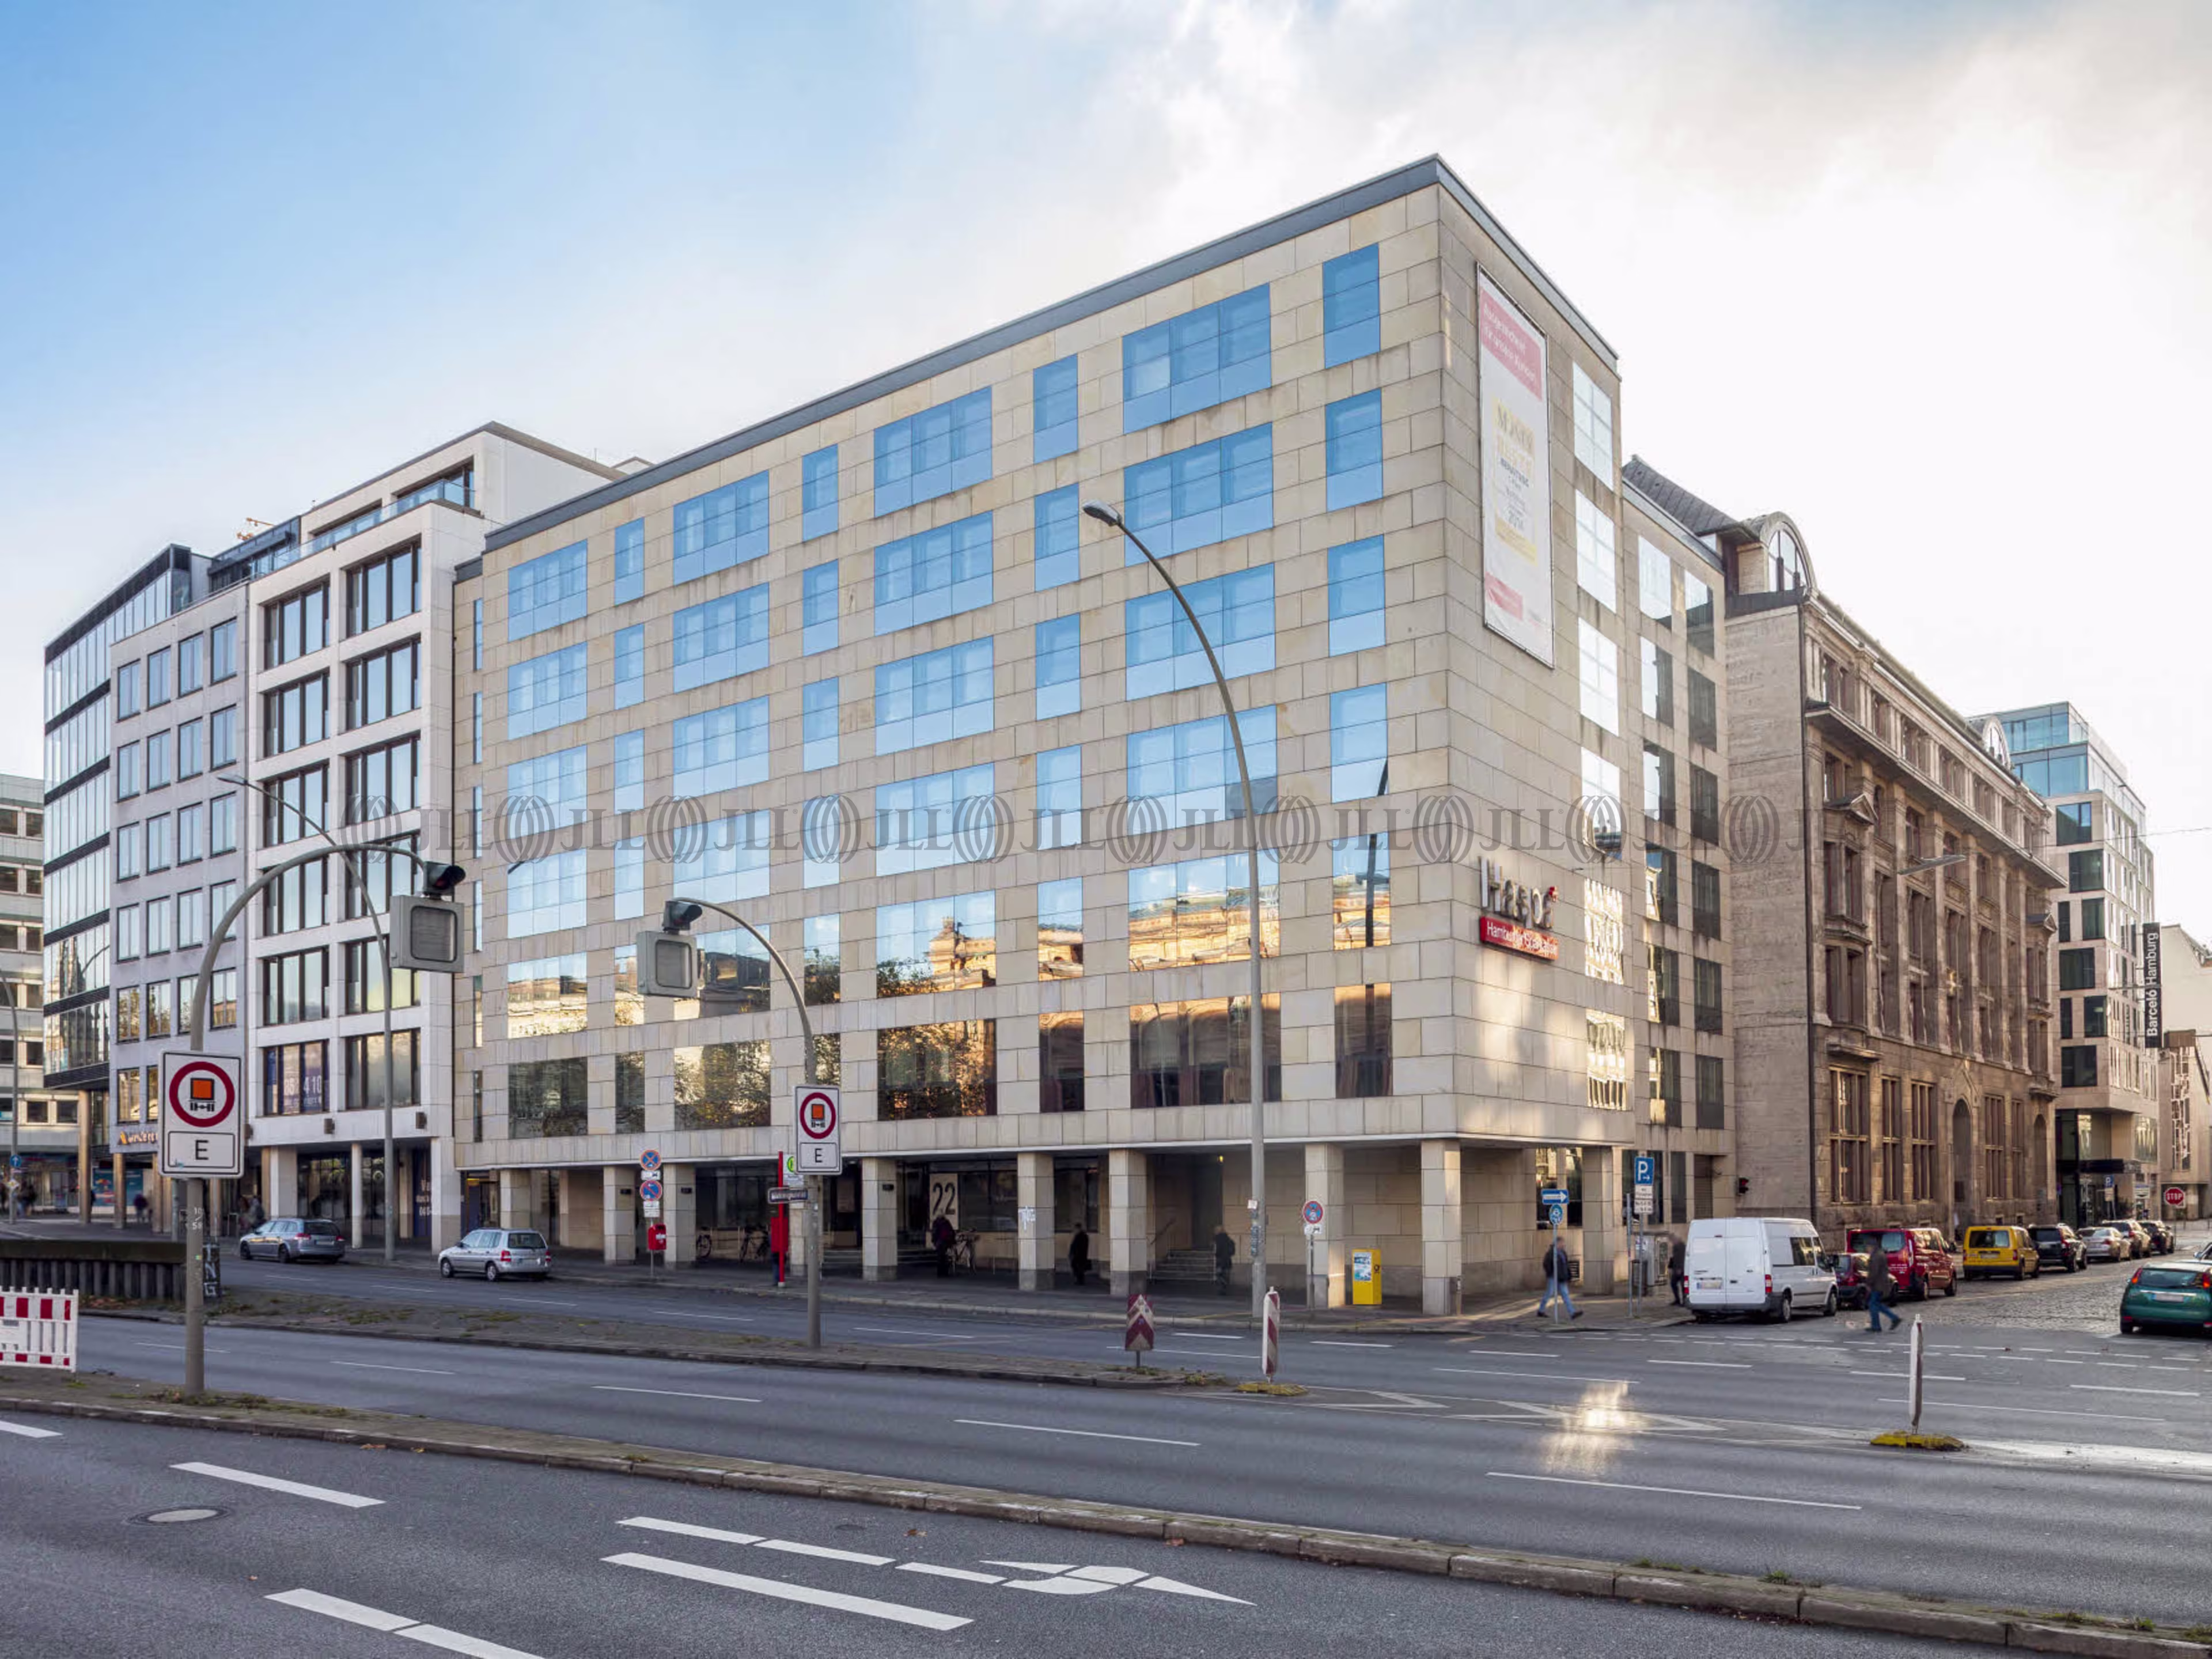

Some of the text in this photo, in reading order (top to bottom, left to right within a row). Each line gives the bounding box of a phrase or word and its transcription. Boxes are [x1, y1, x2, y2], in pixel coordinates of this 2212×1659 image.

[1479, 856, 1554, 929] Haspa
[2145, 932, 2159, 1037] Barceló Hamburg
[195, 1139, 209, 1160] E
[815, 1147, 823, 1163] E
[1637, 1160, 1649, 1181] P
[933, 1182, 956, 1215] 22
[2166, 1192, 2183, 1200] STOP
